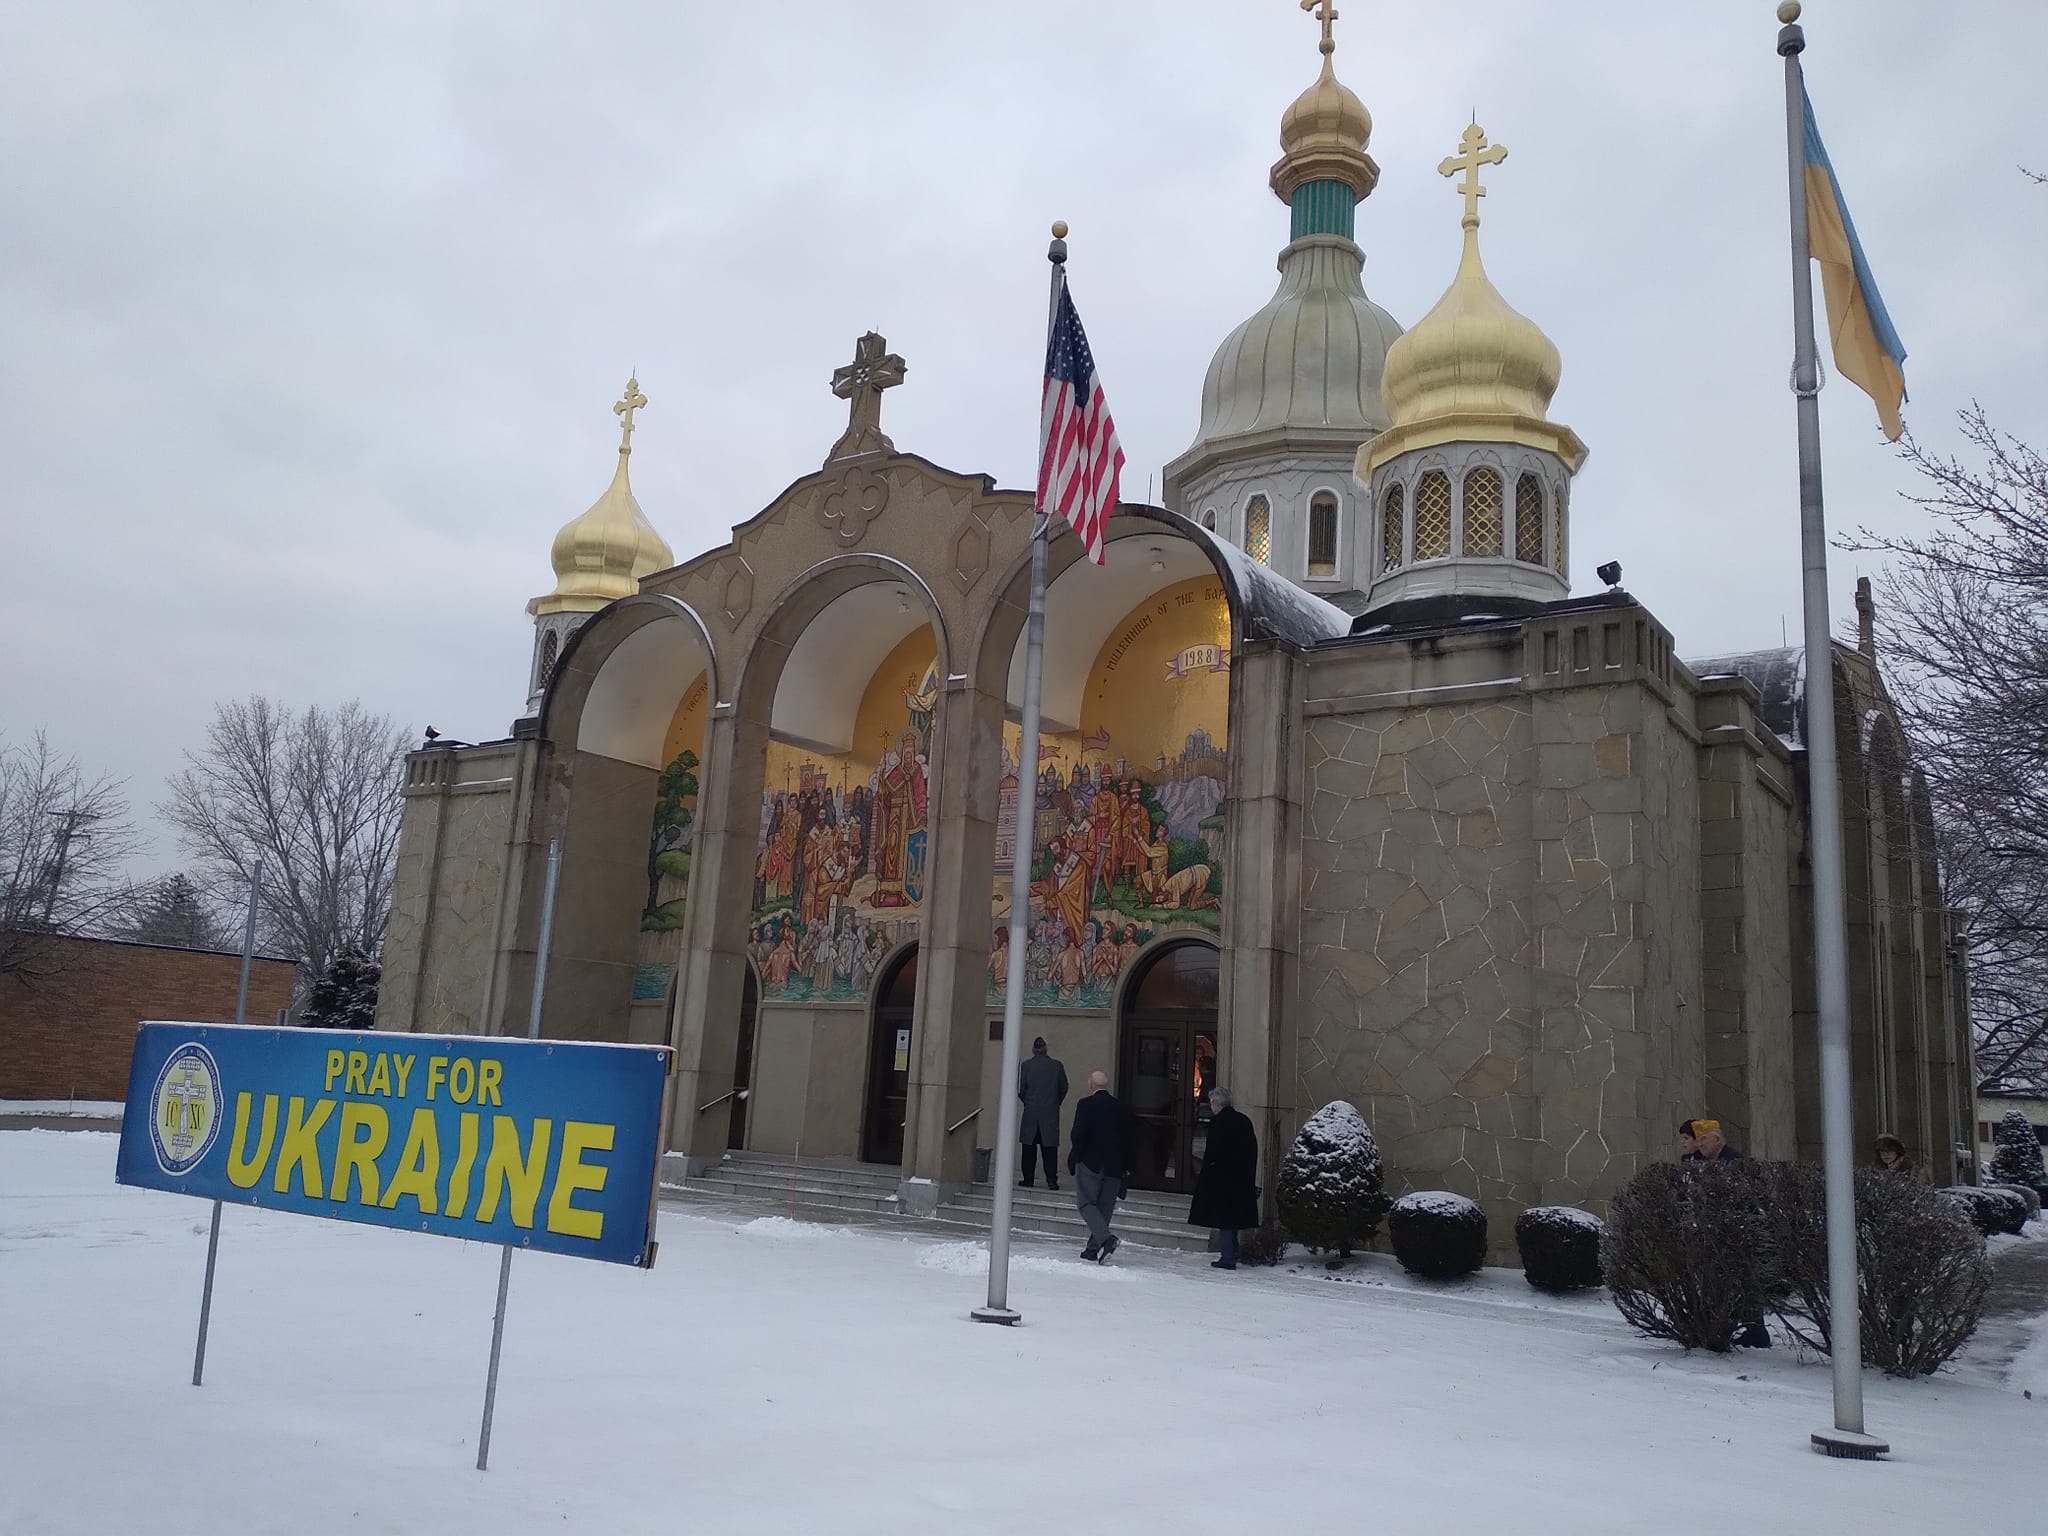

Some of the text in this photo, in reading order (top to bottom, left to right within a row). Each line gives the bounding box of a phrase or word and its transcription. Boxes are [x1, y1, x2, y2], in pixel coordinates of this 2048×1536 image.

[1157, 601, 1168, 616] OF
[1175, 592, 1195, 607] THE
[1184, 648, 1214, 668] 1988
[325, 1049, 502, 1106] PRAY FOR
[226, 1091, 616, 1240] UKRAINE
